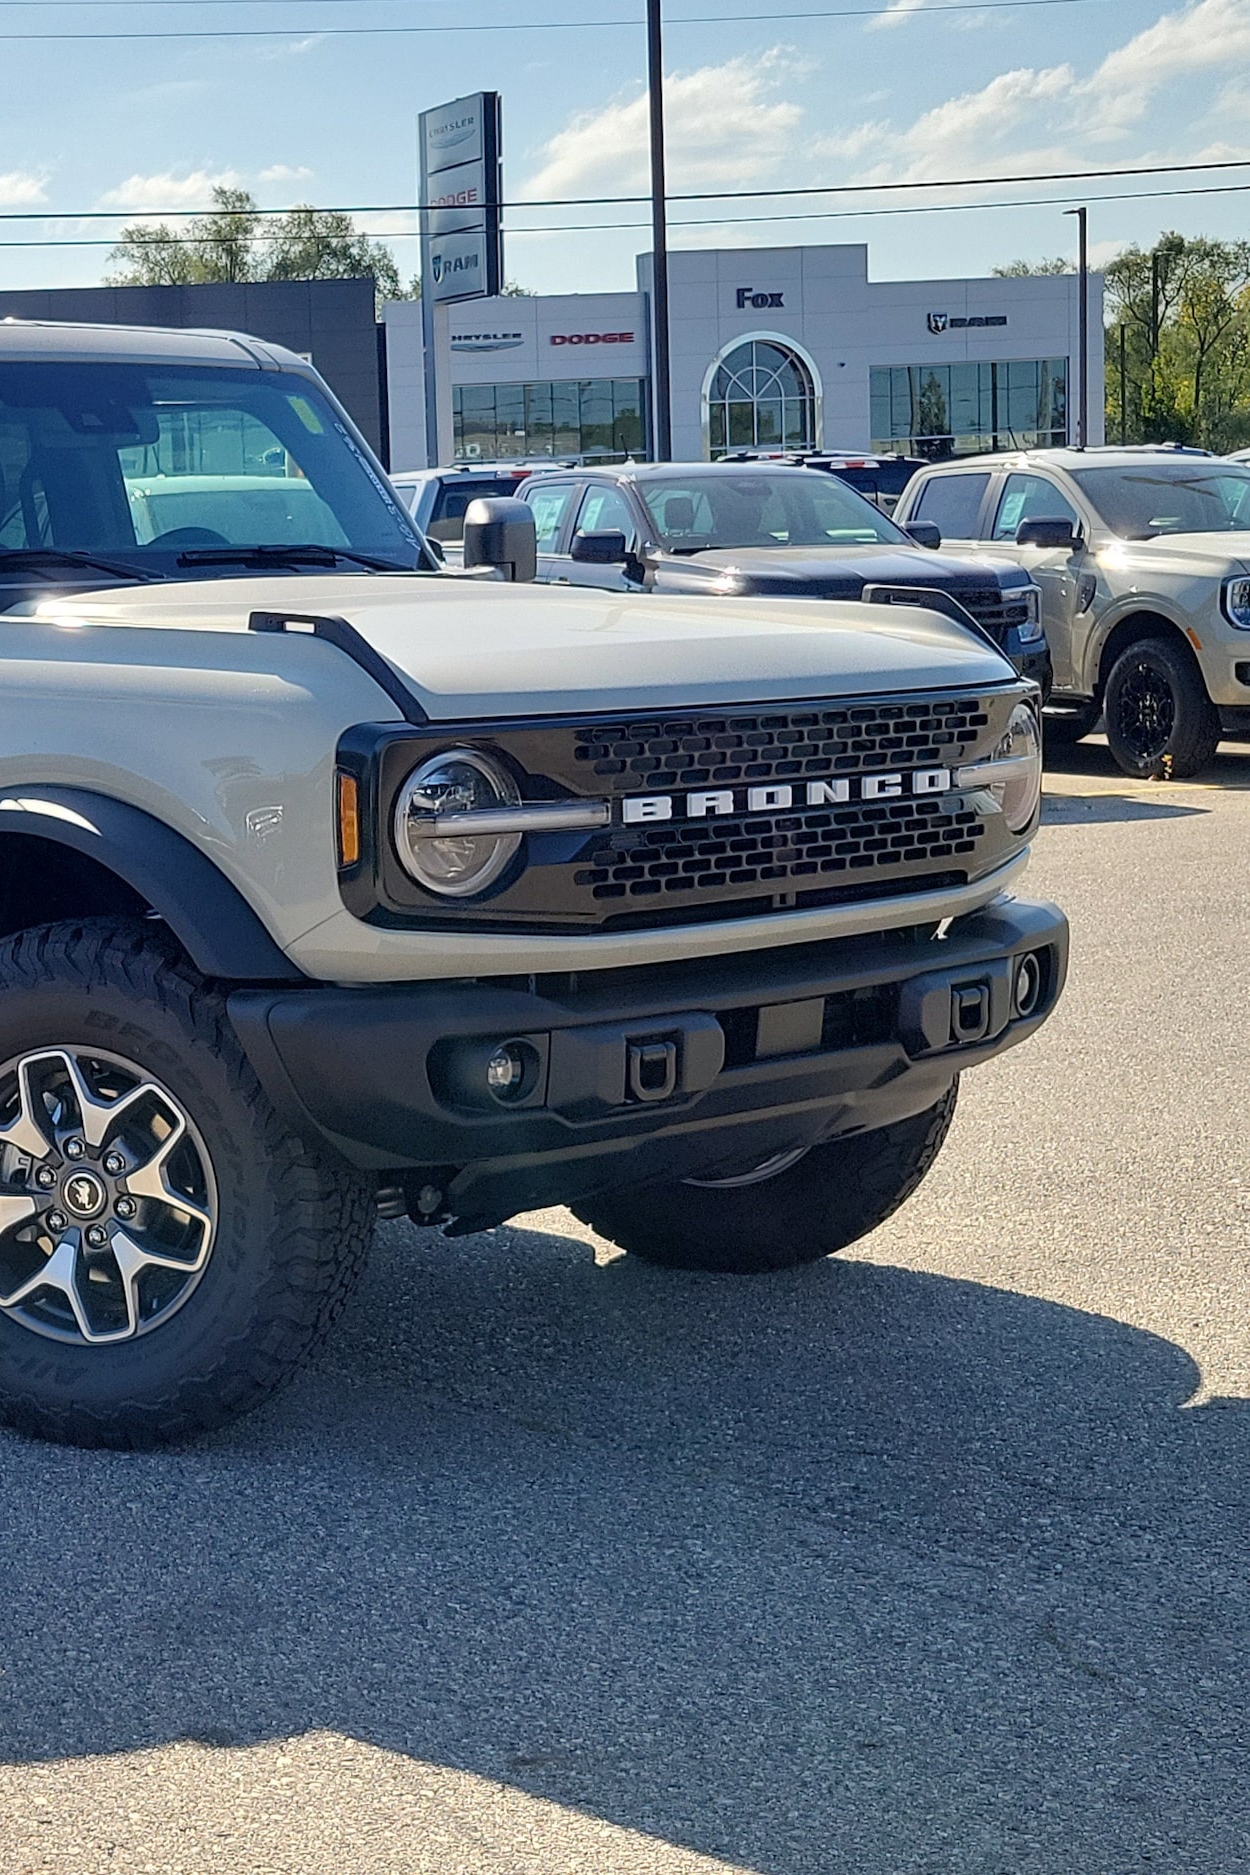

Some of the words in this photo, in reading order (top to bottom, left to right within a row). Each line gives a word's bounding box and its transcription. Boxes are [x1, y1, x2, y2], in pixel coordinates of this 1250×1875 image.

[429, 116, 475, 138] CHRYSLER
[443, 254, 479, 275] RAM
[736, 287, 785, 309] Fox
[451, 332, 522, 342] HRYSLER
[551, 332, 635, 346] DODGE
[622, 769, 951, 823] BRONCO
